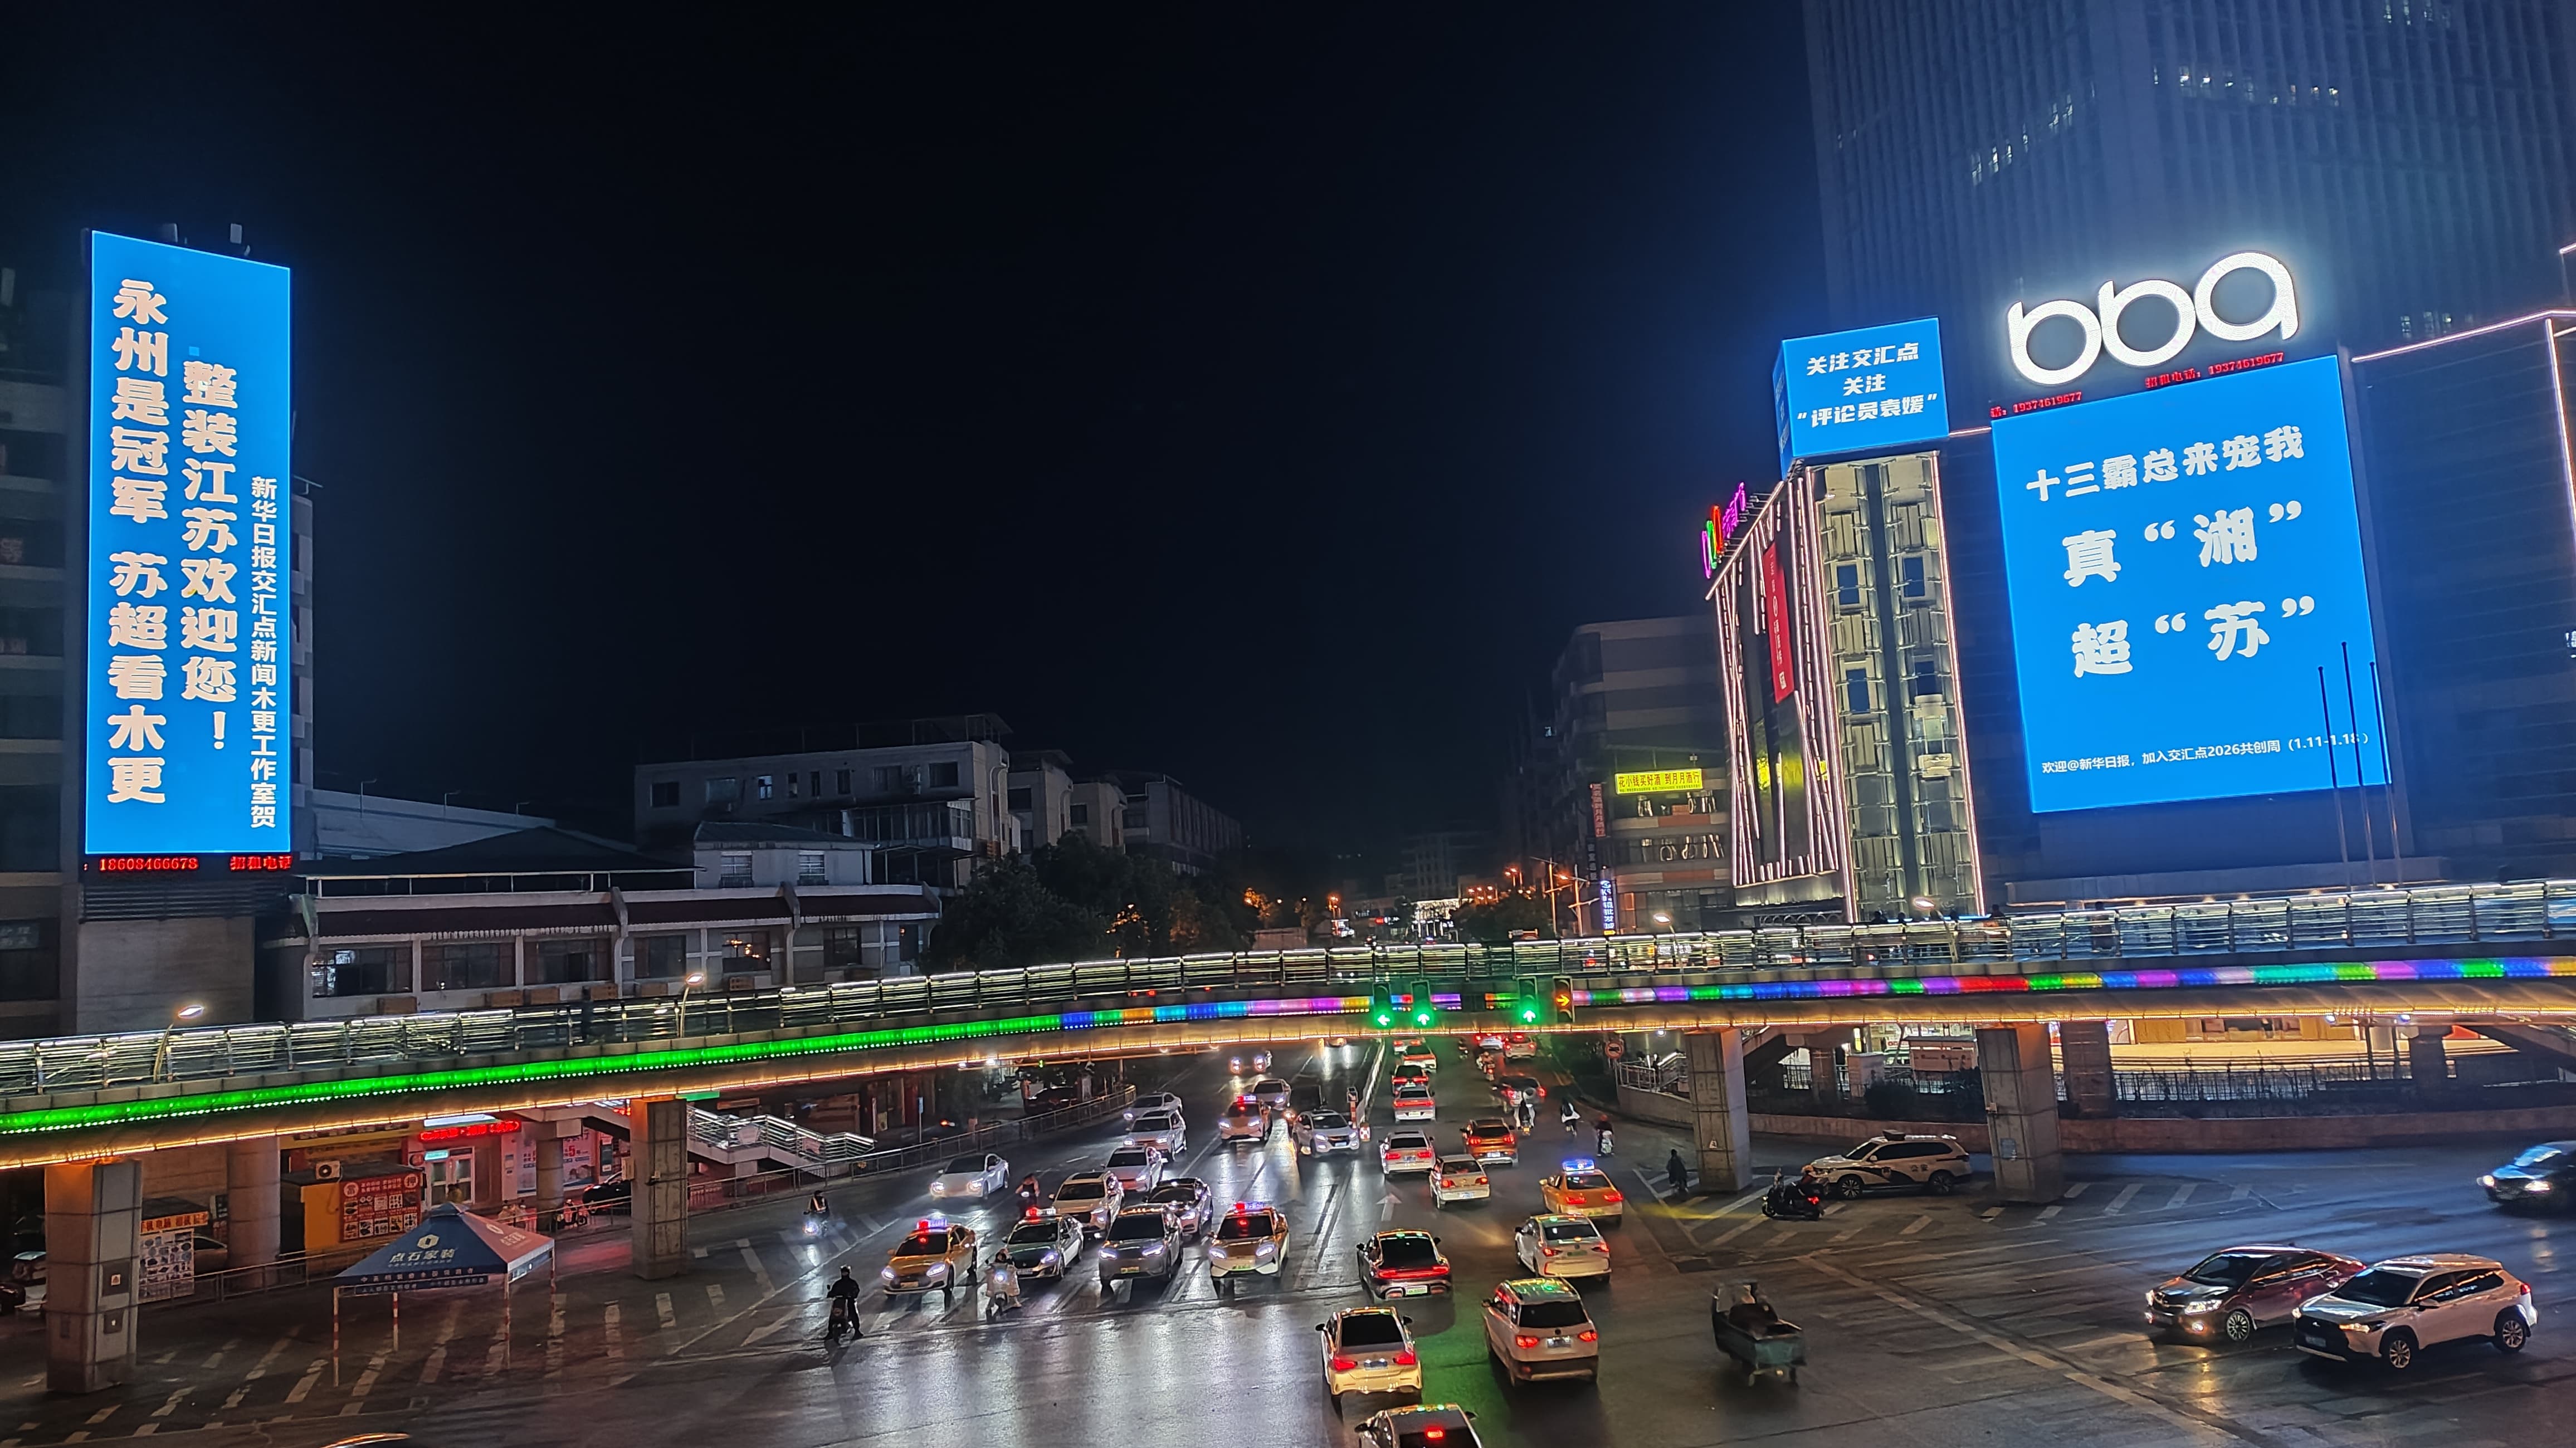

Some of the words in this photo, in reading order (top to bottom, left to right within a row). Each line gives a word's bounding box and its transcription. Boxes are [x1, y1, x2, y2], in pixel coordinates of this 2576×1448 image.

[1807, 343, 1919, 376] 关注交汇点
[2208, 351, 2284, 375] 19374619677
[110, 278, 169, 524] 永州是冠军
[1843, 374, 1886, 396] 关注
[2013, 391, 2082, 413] 19374619677
[1797, 393, 1938, 428] “评论员袁媛”
[2026, 425, 2305, 502] 十三霸总来宠我
[180, 360, 238, 750] 整装江苏欢迎您！
[251, 476, 277, 828] 新华日报交汇点新闻木更工作室贺
[107, 551, 168, 804] 苏超看木更
[100, 857, 199, 871] 18608466678
